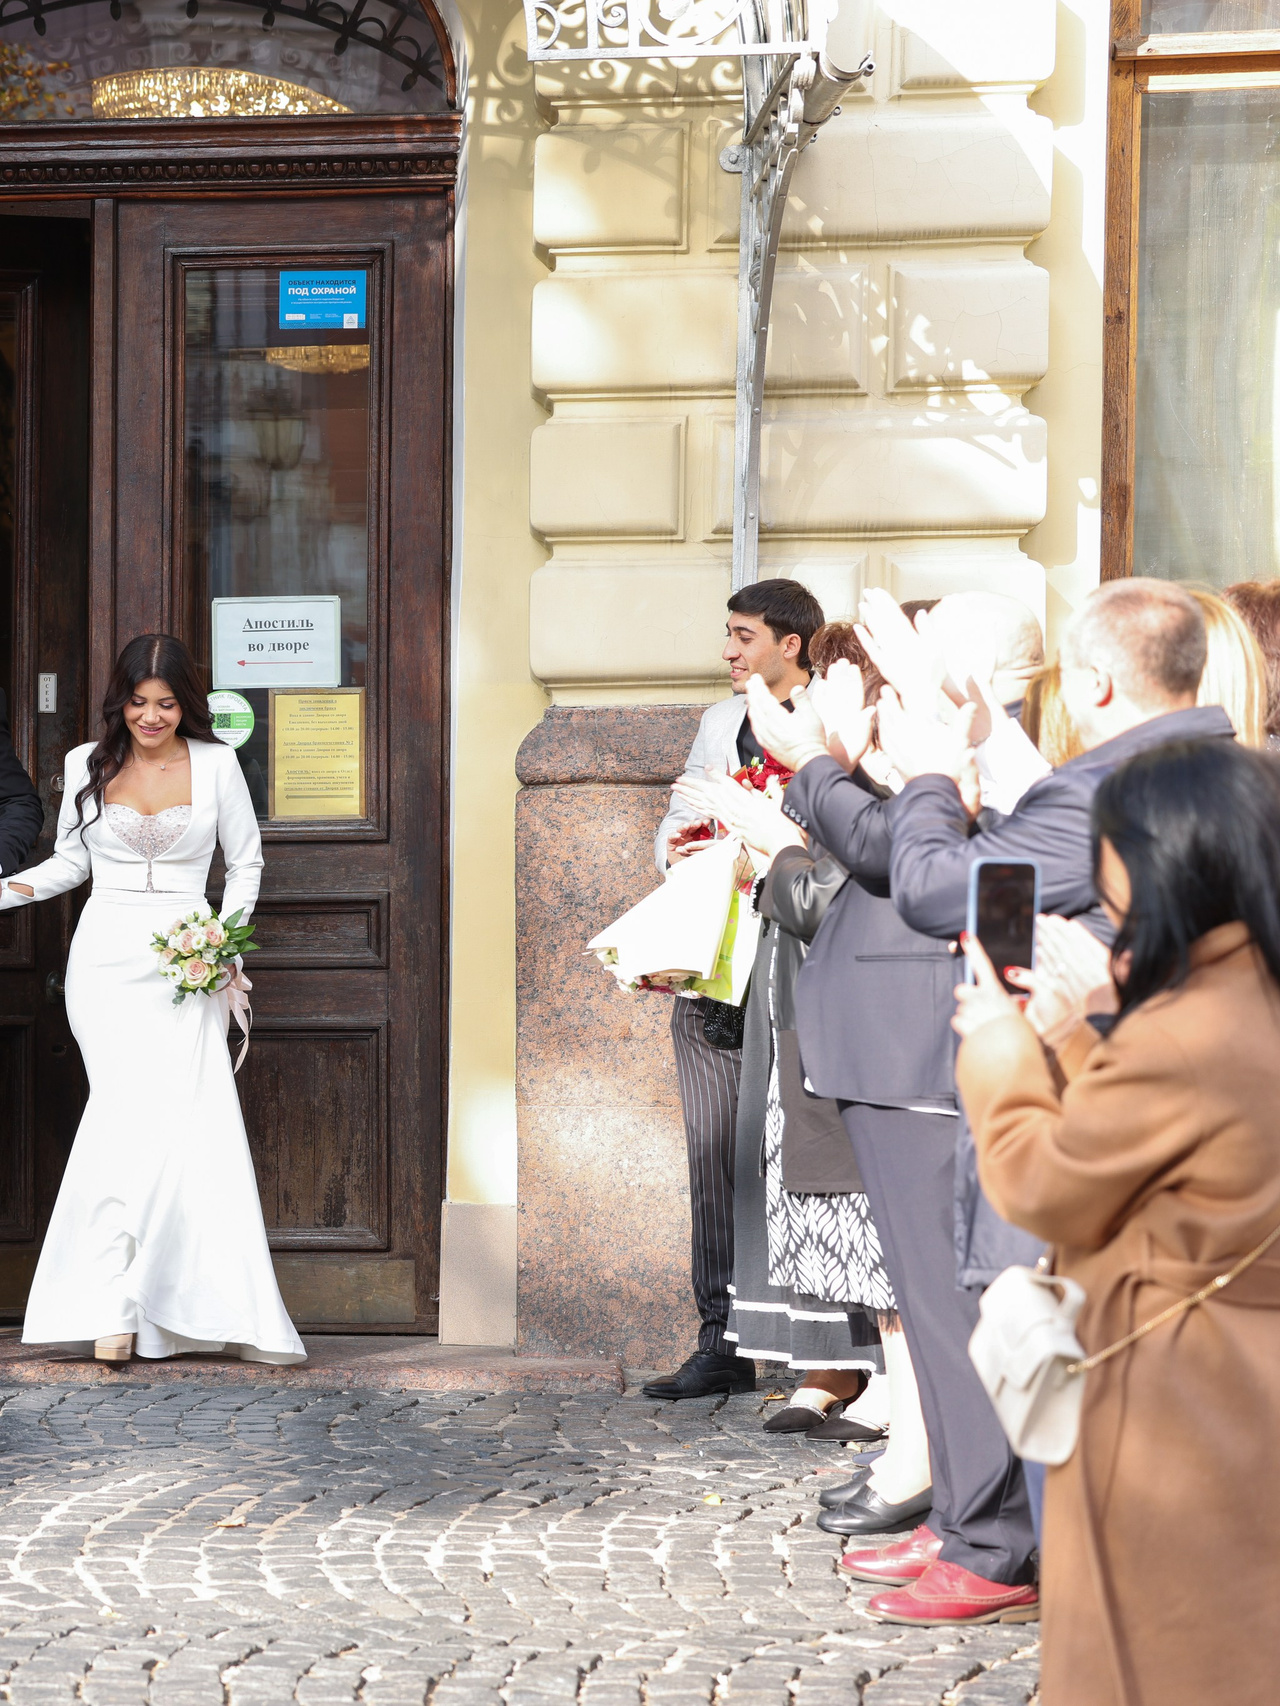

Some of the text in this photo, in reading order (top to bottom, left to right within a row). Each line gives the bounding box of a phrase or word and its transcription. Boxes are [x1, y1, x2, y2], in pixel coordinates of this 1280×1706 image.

[288, 286, 356, 296] ПОД ОХРАНОЙ
[242, 618, 314, 630] Апостиль
[248, 641, 310, 653] во дворе
[227, 694, 248, 711] ПРОЕКТА
